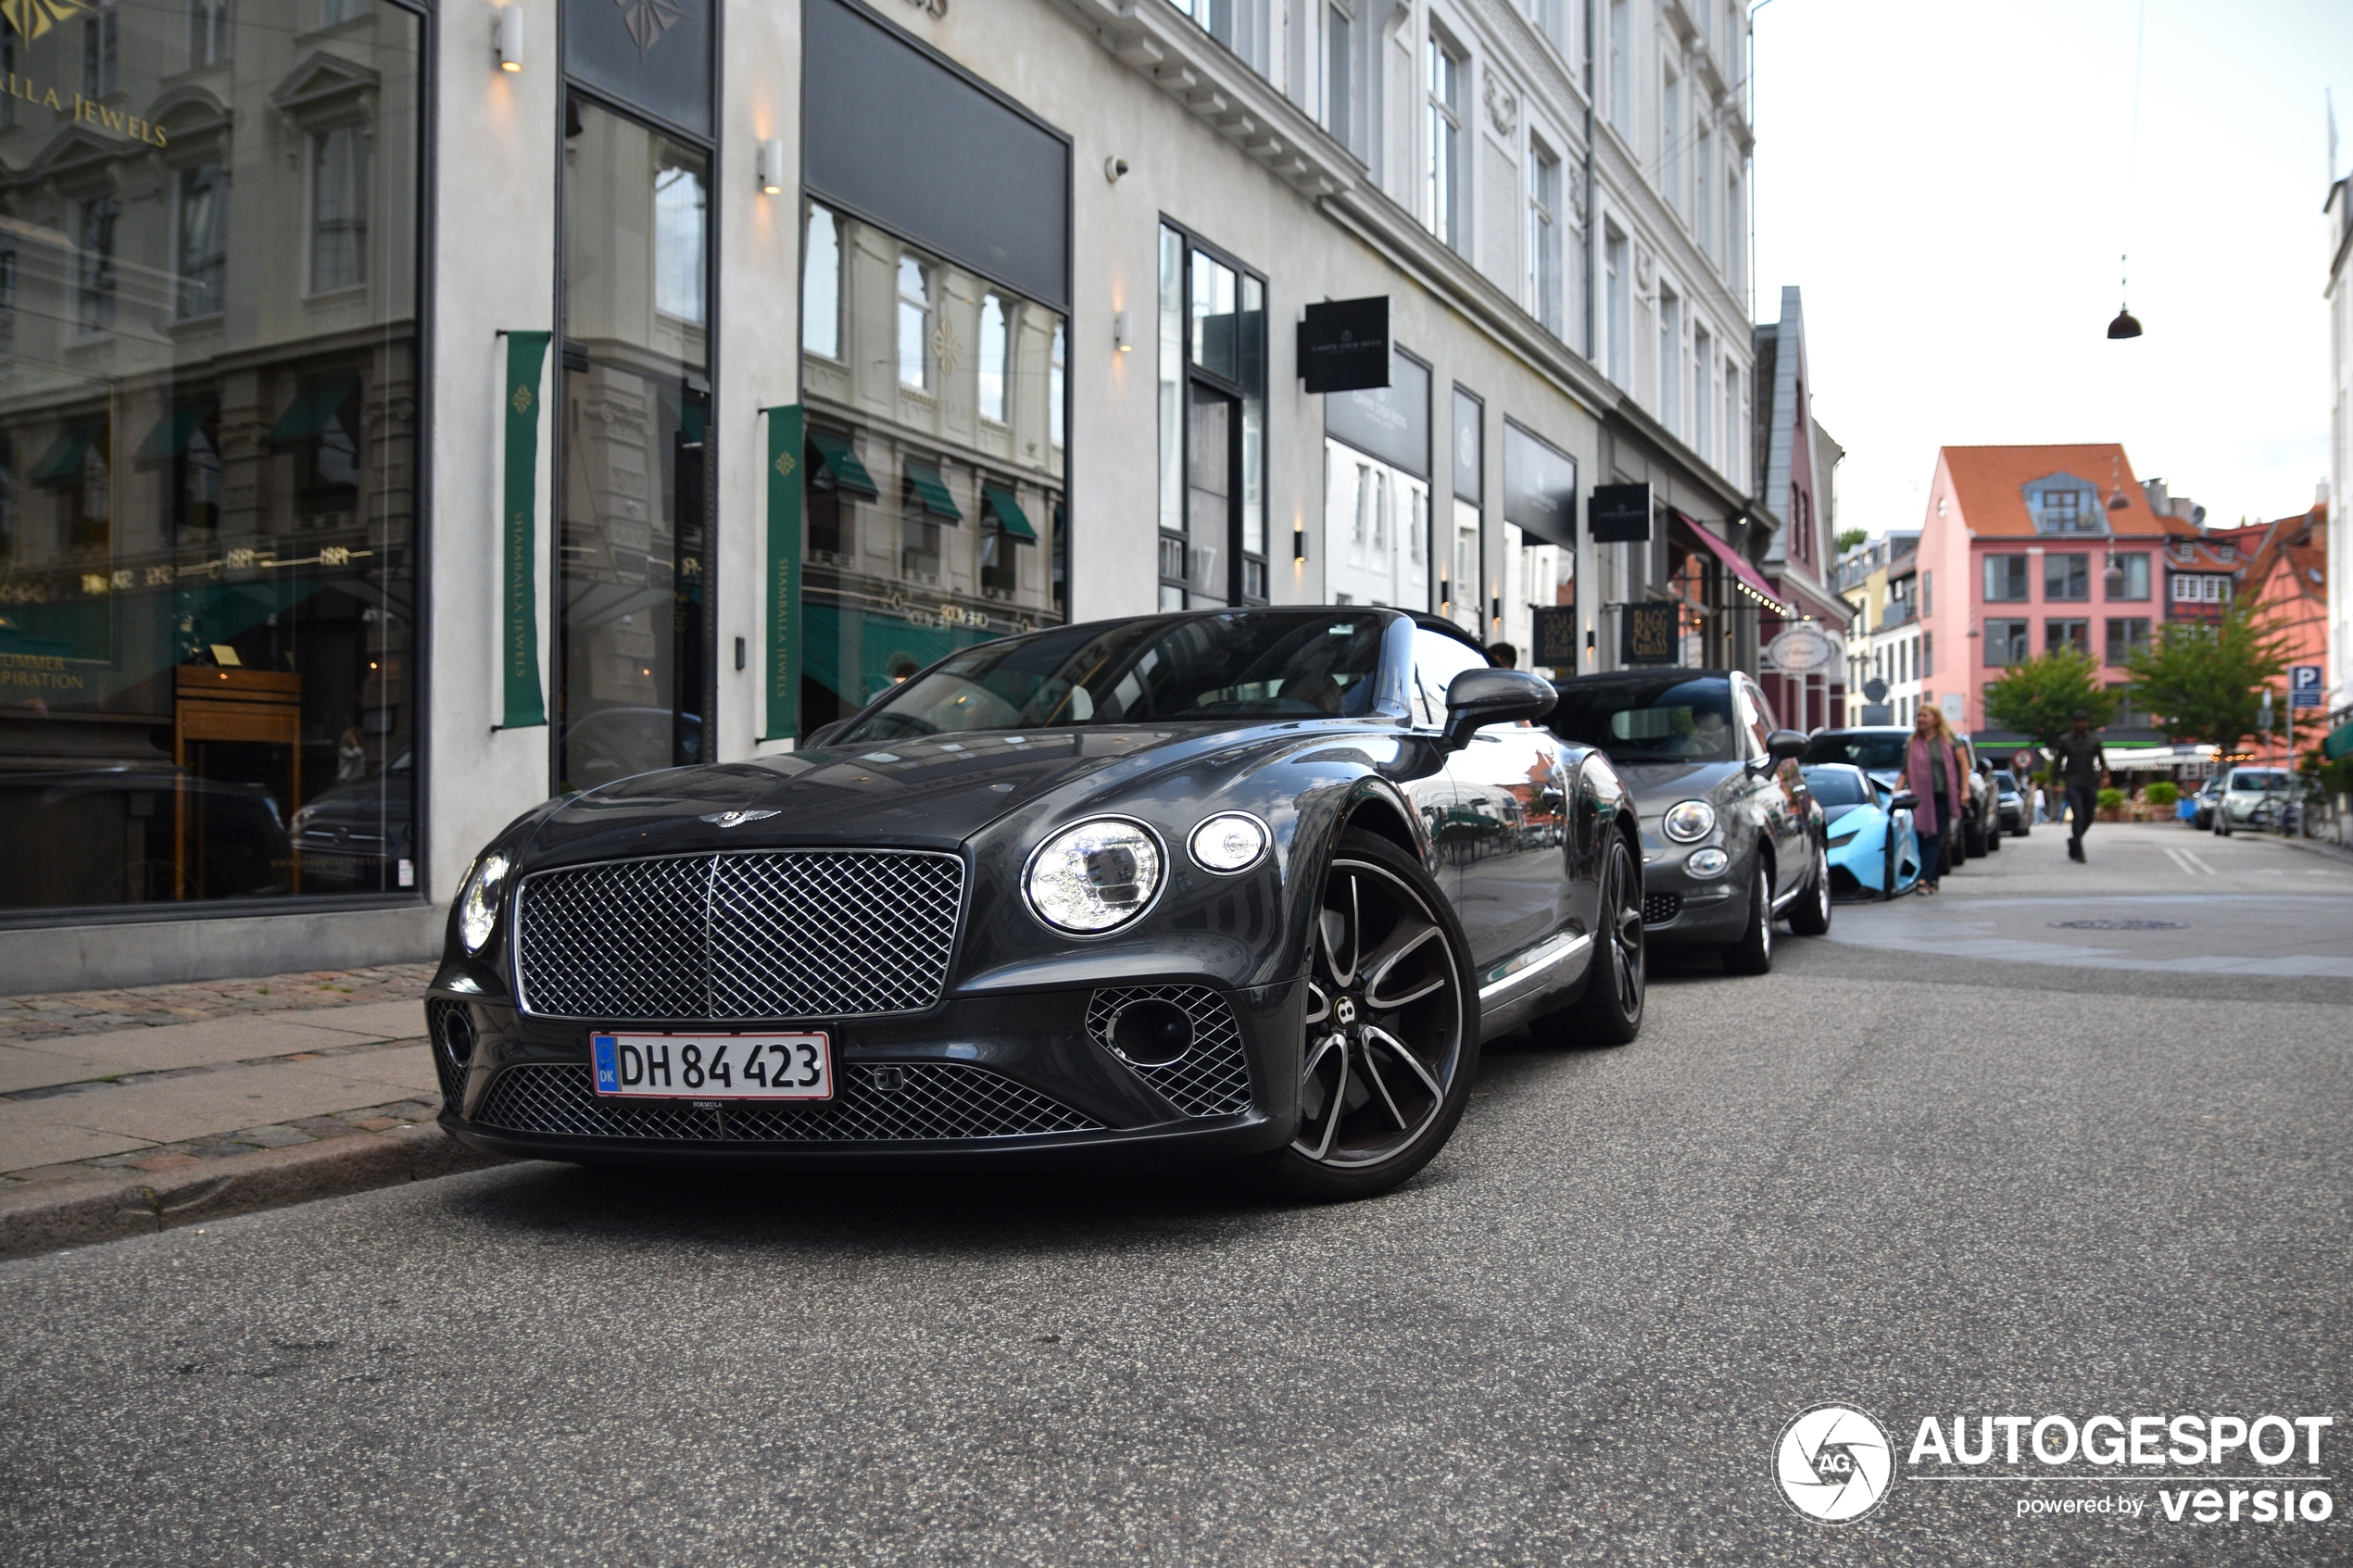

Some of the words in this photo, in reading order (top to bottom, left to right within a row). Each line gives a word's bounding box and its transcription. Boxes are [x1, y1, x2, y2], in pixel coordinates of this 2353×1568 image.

[73, 93, 168, 148] JEWELS
[513, 511, 524, 613] SHAMBALLA
[778, 557, 788, 644] SHAMBALLA
[0, 654, 66, 671] UMMER
[513, 620, 526, 678] JEWELS
[0, 670, 84, 689] PIRATION
[777, 648, 786, 698] JEWELS
[2297, 667, 2317, 690] P
[599, 1070, 614, 1083] DK
[619, 1044, 672, 1086] DH
[682, 1044, 732, 1088] 84
[743, 1043, 821, 1088] 423
